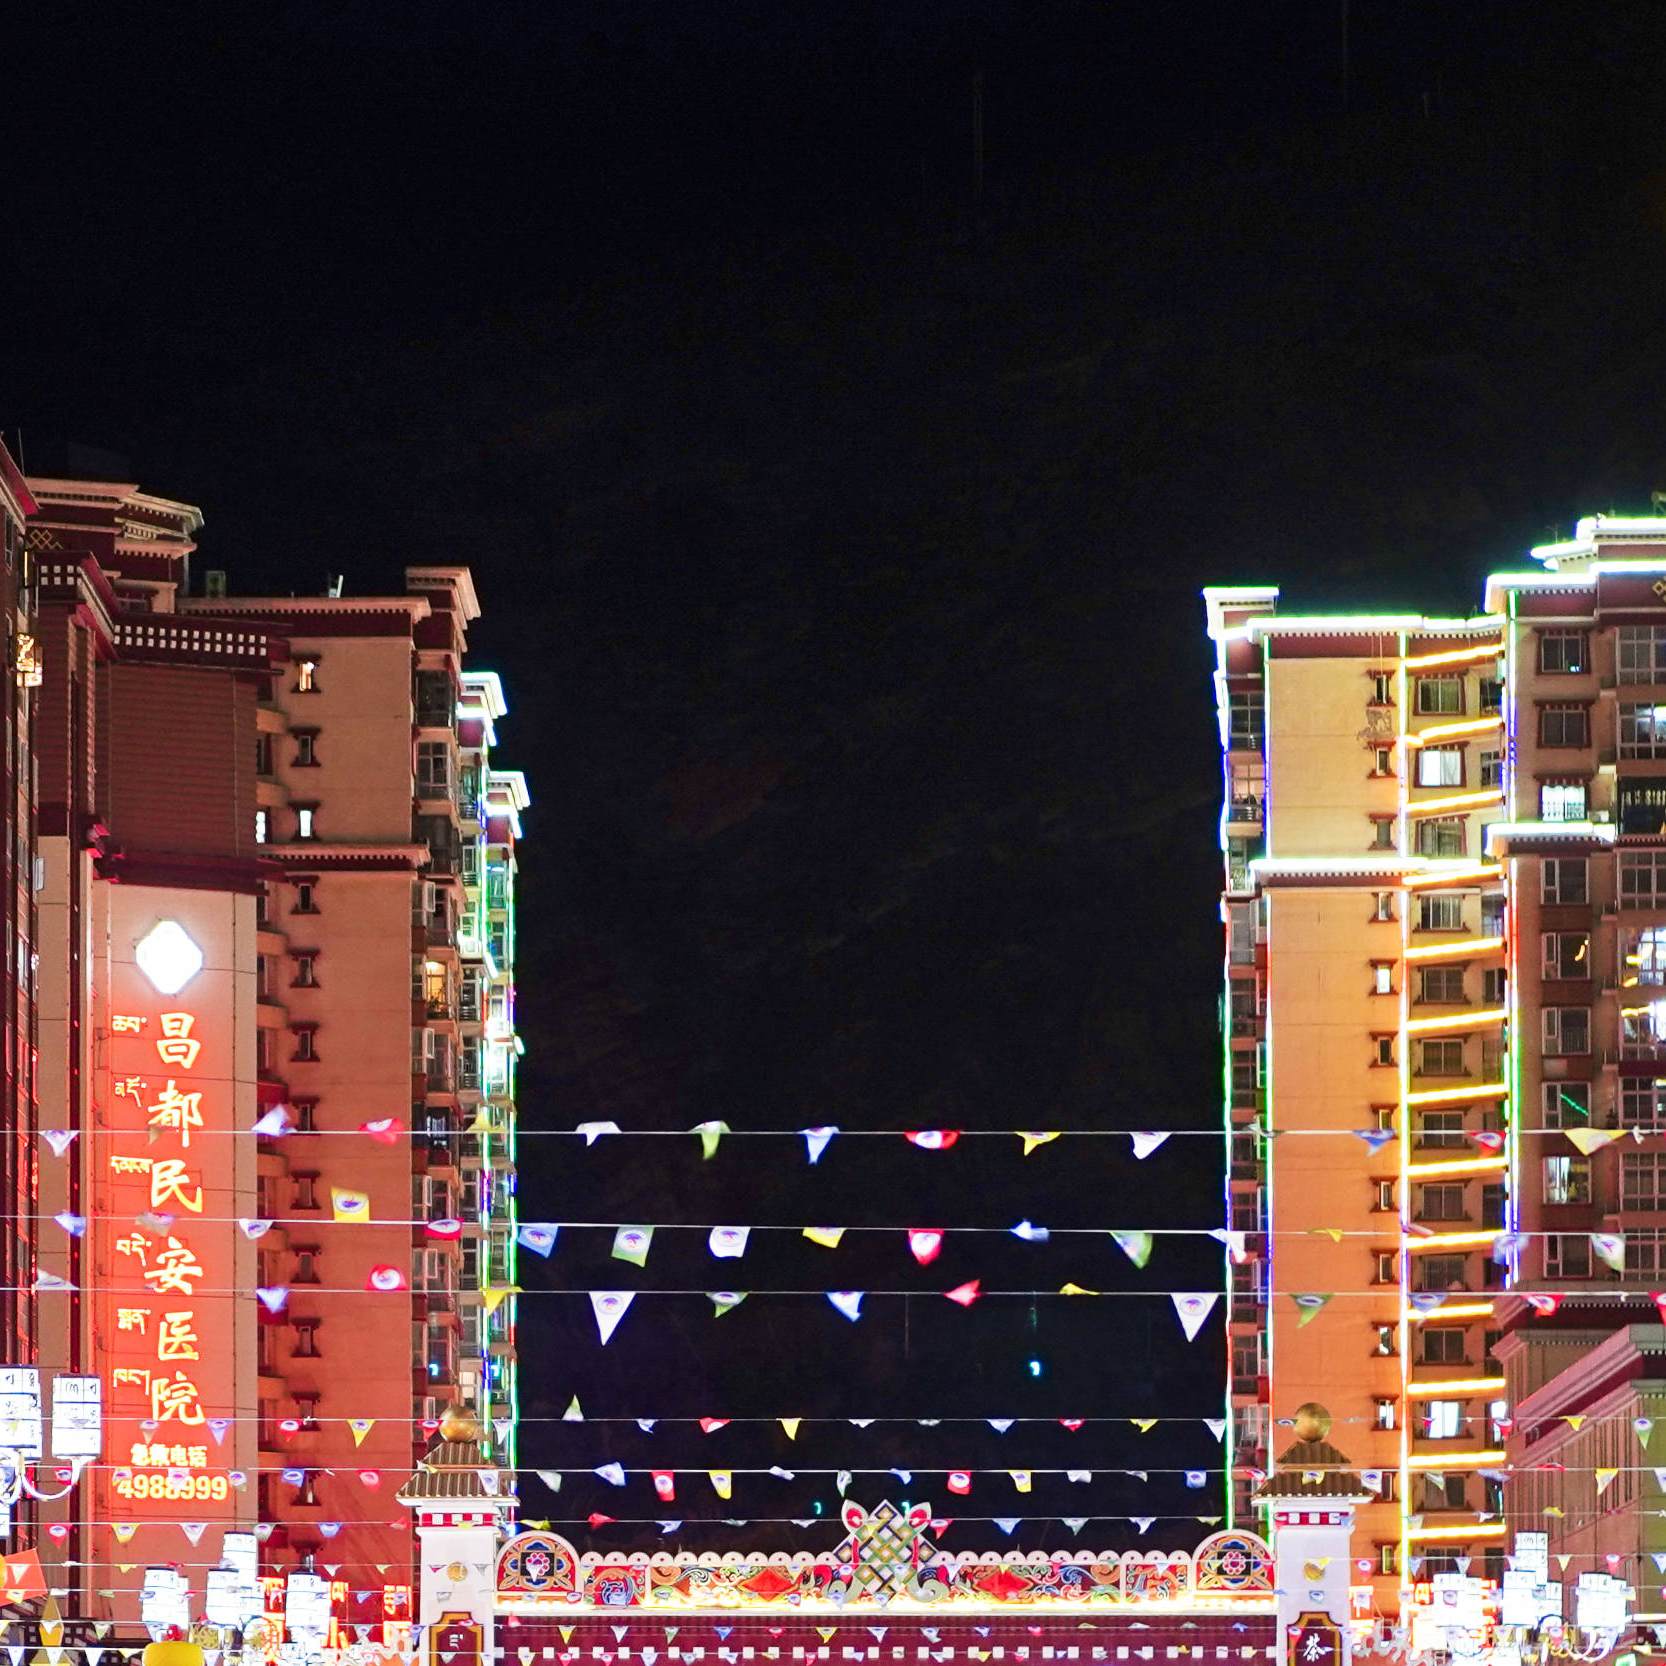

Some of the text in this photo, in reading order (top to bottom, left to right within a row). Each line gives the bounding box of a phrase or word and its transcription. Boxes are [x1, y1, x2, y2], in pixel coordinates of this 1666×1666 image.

[144, 1012, 205, 1425] 昌都民安医院
[130, 1443, 208, 1468] 急救电话
